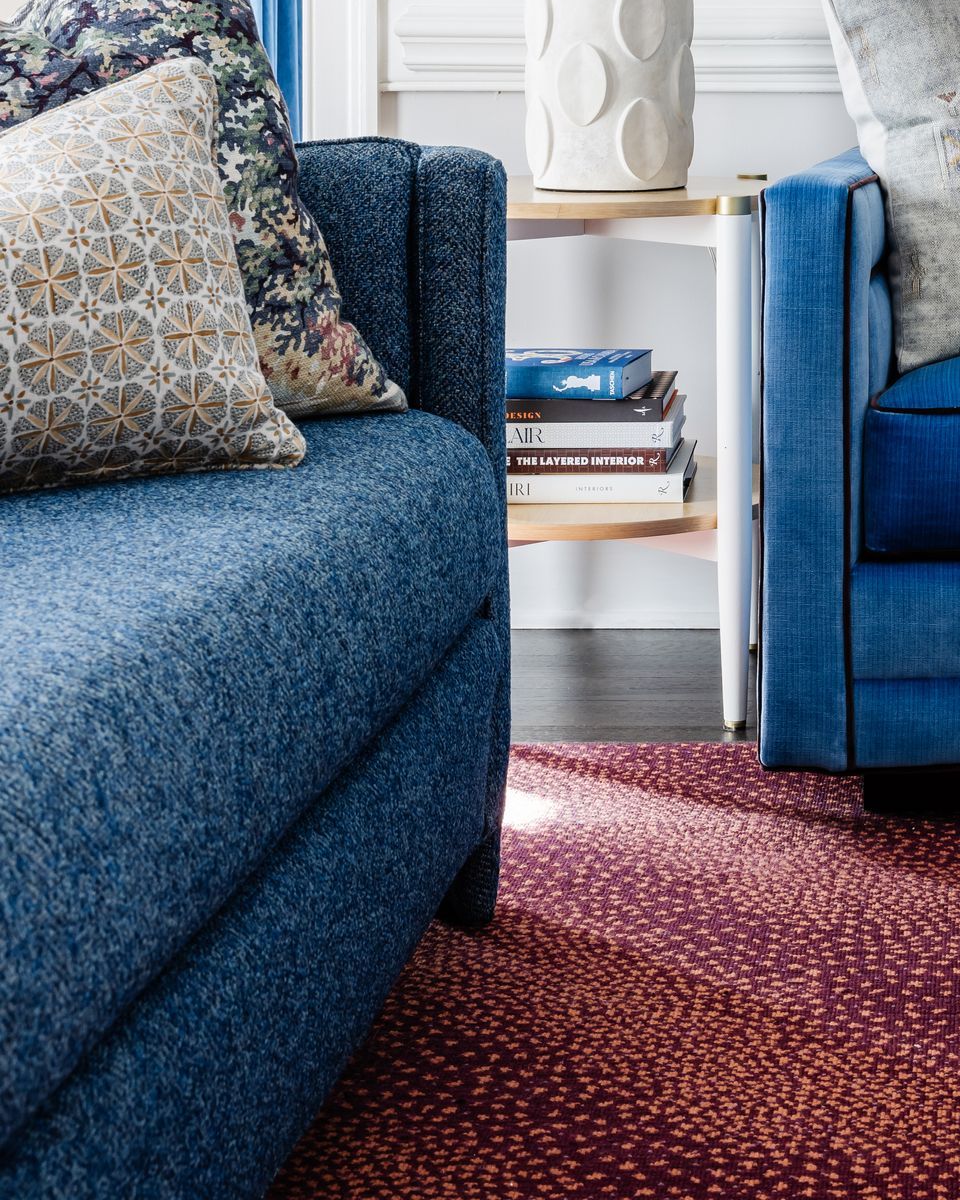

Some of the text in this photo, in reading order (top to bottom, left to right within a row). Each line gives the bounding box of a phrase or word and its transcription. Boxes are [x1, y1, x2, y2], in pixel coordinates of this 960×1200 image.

[508, 427, 545, 444] AIR
[516, 456, 538, 466] THE
[538, 456, 589, 466] LAYERED
[590, 456, 645, 466] INTERIOR
